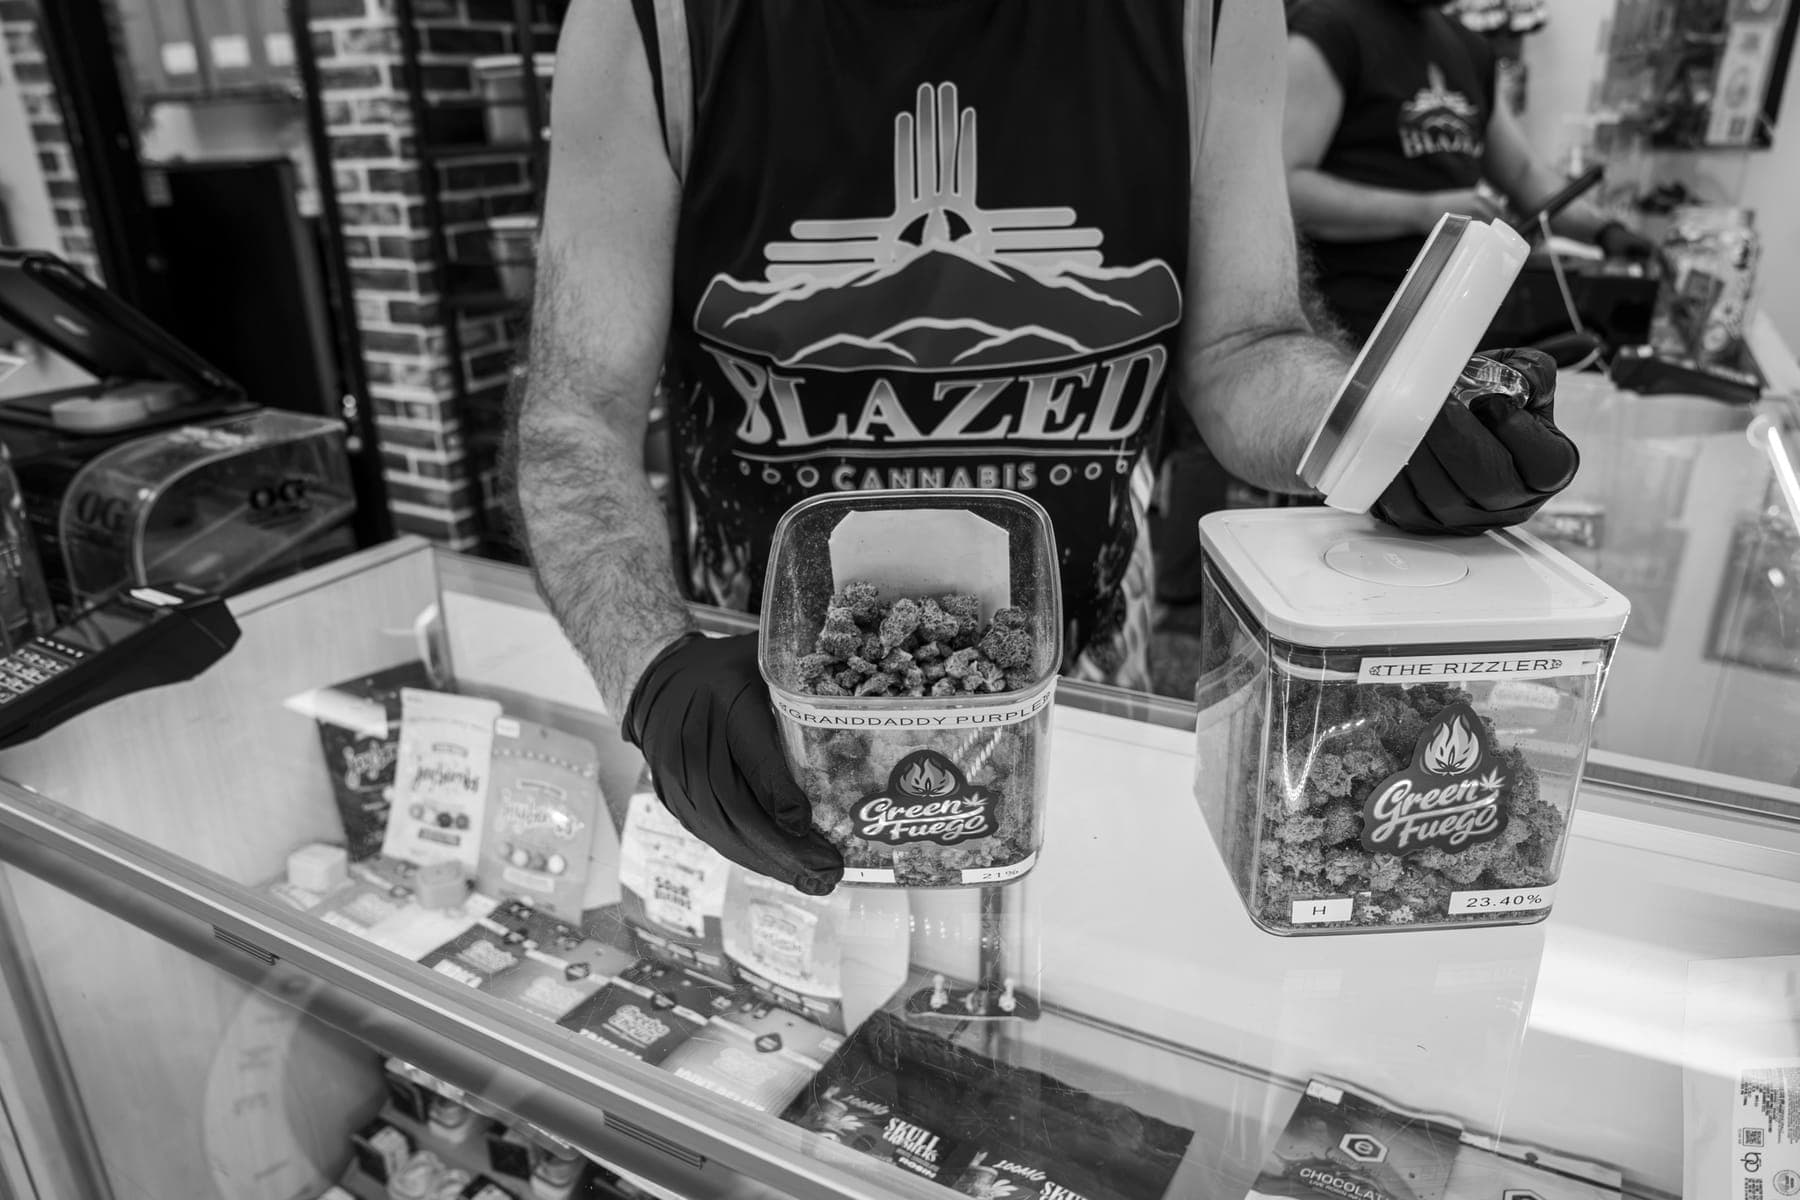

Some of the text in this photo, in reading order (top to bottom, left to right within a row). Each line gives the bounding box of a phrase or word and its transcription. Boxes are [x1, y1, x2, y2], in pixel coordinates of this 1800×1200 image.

[700, 345, 1167, 447] BLAZED
[831, 462, 1038, 490] CANNABIS
[1383, 659, 1549, 676] THE RIZZLER
[788, 699, 1041, 726] GRANDDADDY PURPLE
[859, 797, 963, 835] Green
[1371, 779, 1480, 843] Green
[889, 815, 989, 839] Fuego
[1397, 804, 1499, 847] Fuego
[1312, 905, 1327, 916] H
[1466, 893, 1543, 909] 23.40%
[1300, 1167, 1393, 1200] CHOCOLAT
